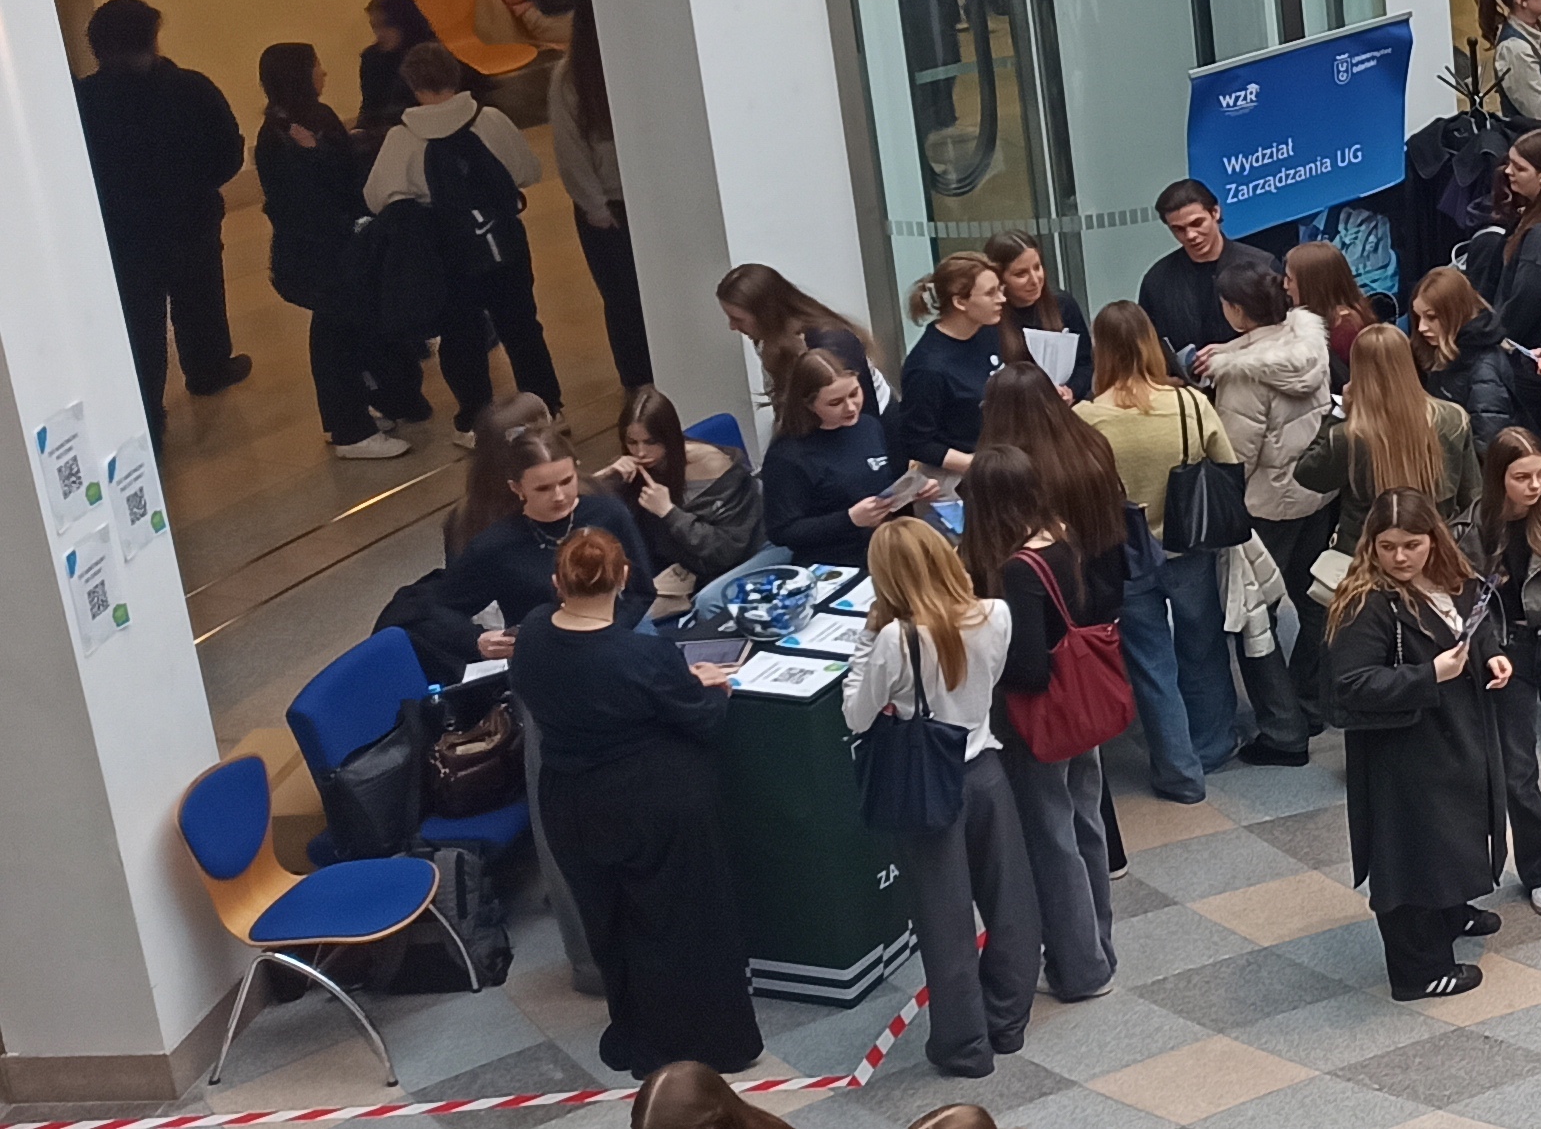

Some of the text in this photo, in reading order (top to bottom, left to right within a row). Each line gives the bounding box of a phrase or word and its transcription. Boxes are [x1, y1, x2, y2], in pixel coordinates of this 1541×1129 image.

[1219, 90, 1258, 109] WZR
[1223, 138, 1294, 176] Wydział
[1225, 145, 1363, 204] Zarządzania UG
